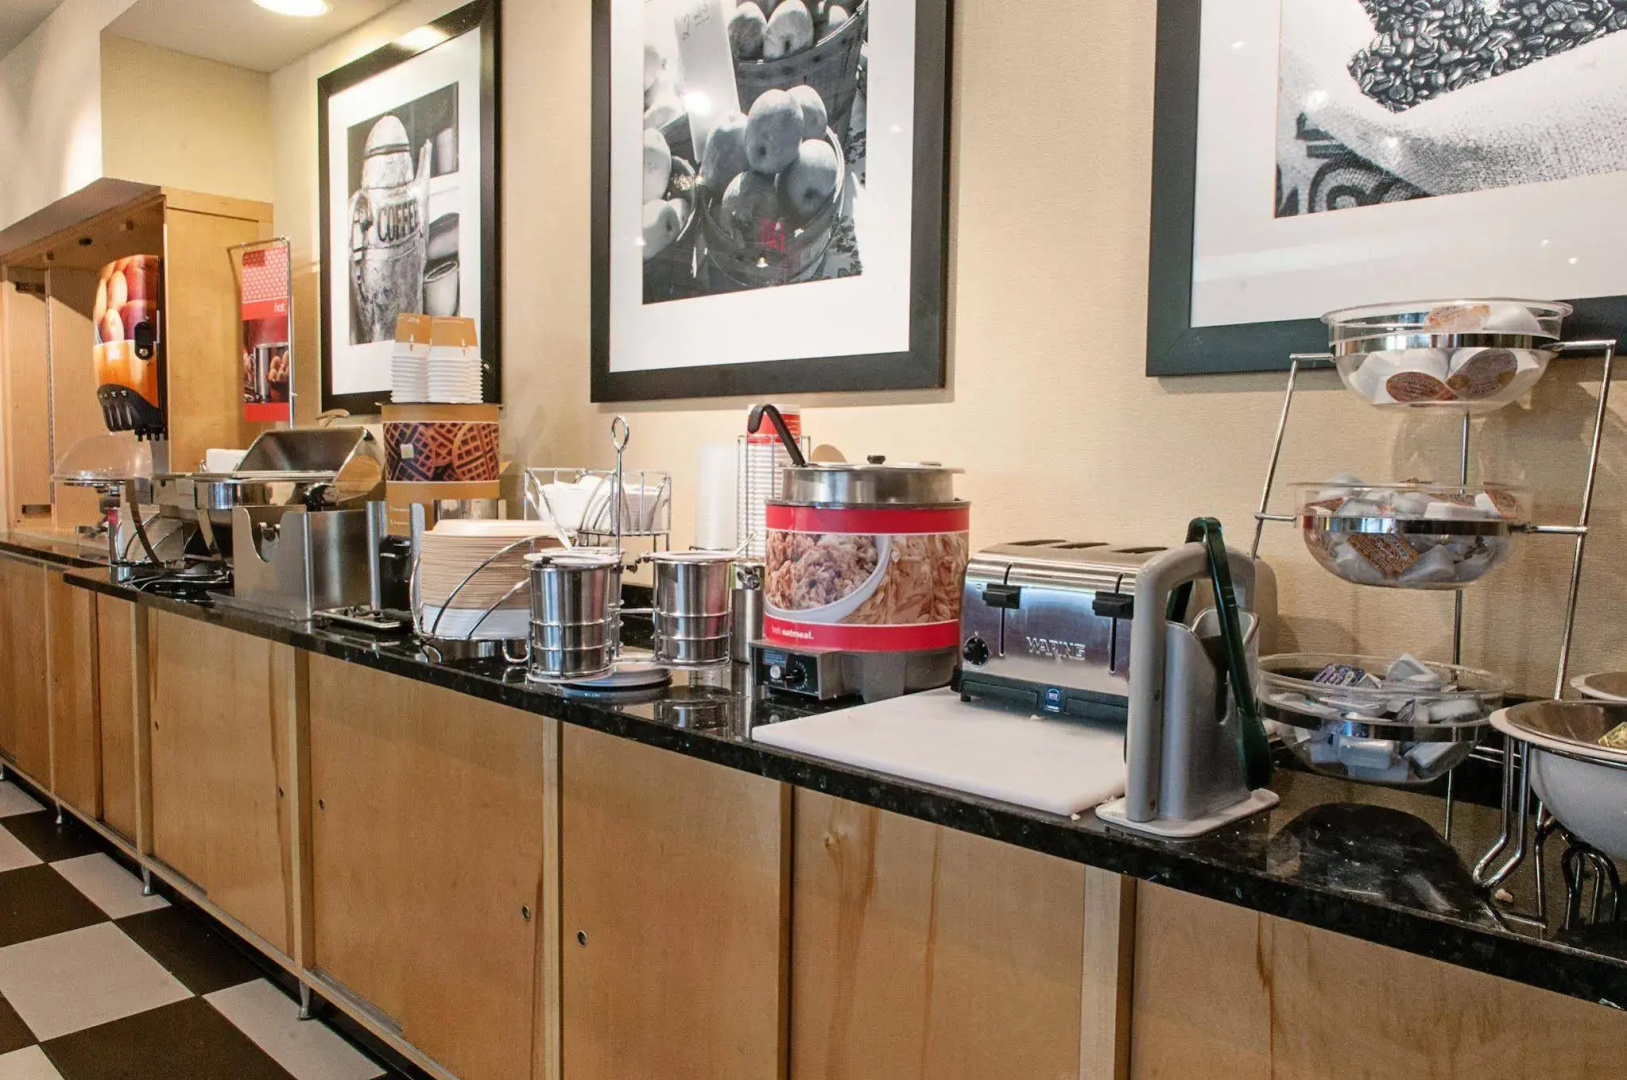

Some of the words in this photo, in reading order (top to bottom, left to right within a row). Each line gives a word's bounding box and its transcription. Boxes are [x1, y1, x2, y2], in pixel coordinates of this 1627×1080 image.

[377, 198, 419, 242] COFFEE
[782, 629, 814, 640] oatmeal.
[1026, 636, 1086, 661] WARING
